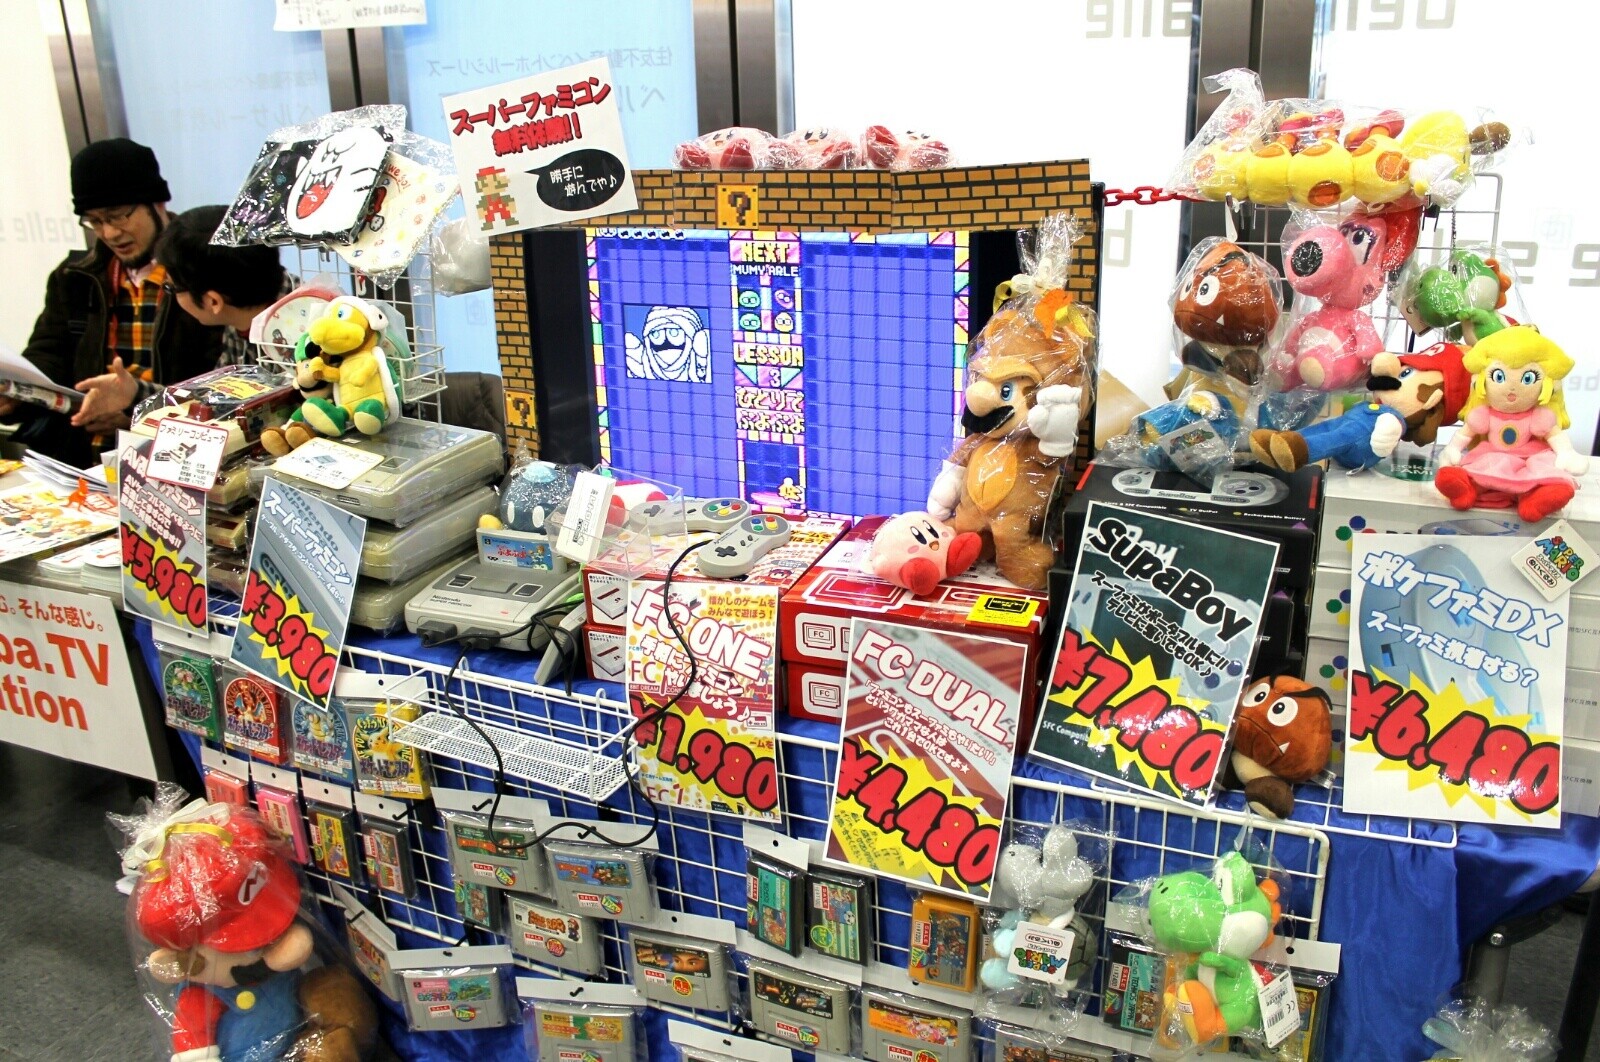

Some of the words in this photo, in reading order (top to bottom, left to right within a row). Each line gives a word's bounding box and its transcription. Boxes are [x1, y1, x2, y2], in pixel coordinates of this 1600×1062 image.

[450, 77, 611, 136] スーパーファミコン
[549, 165, 584, 184] 勝手に
[741, 242, 790, 263] NEXT
[733, 343, 805, 367] LESSON
[768, 368, 781, 388] 3
[736, 387, 805, 412] ひとりで
[737, 410, 805, 433] ぷよぷよ
[264, 490, 352, 585] スーパーファミコン
[1535, 538, 1580, 582] MARIO
[1551, 536, 1584, 569] SUPER
[1089, 517, 1252, 644] SupaBoy
[1359, 551, 1563, 647] ポケファミDX
[633, 588, 691, 639] FC
[688, 616, 772, 681] ONE
[631, 660, 657, 684] FC
[819, 689, 831, 698] FC
[853, 629, 914, 680] FC
[906, 659, 1007, 744] DUAL
[0, 673, 89, 731] tion
[1014, 947, 1067, 968] MARIO
[1018, 959, 1058, 975] SUPER
[1121, 967, 1129, 990] SALE
[1131, 976, 1140, 1006] TECHNOS
[891, 1046, 911, 1056] SALE
